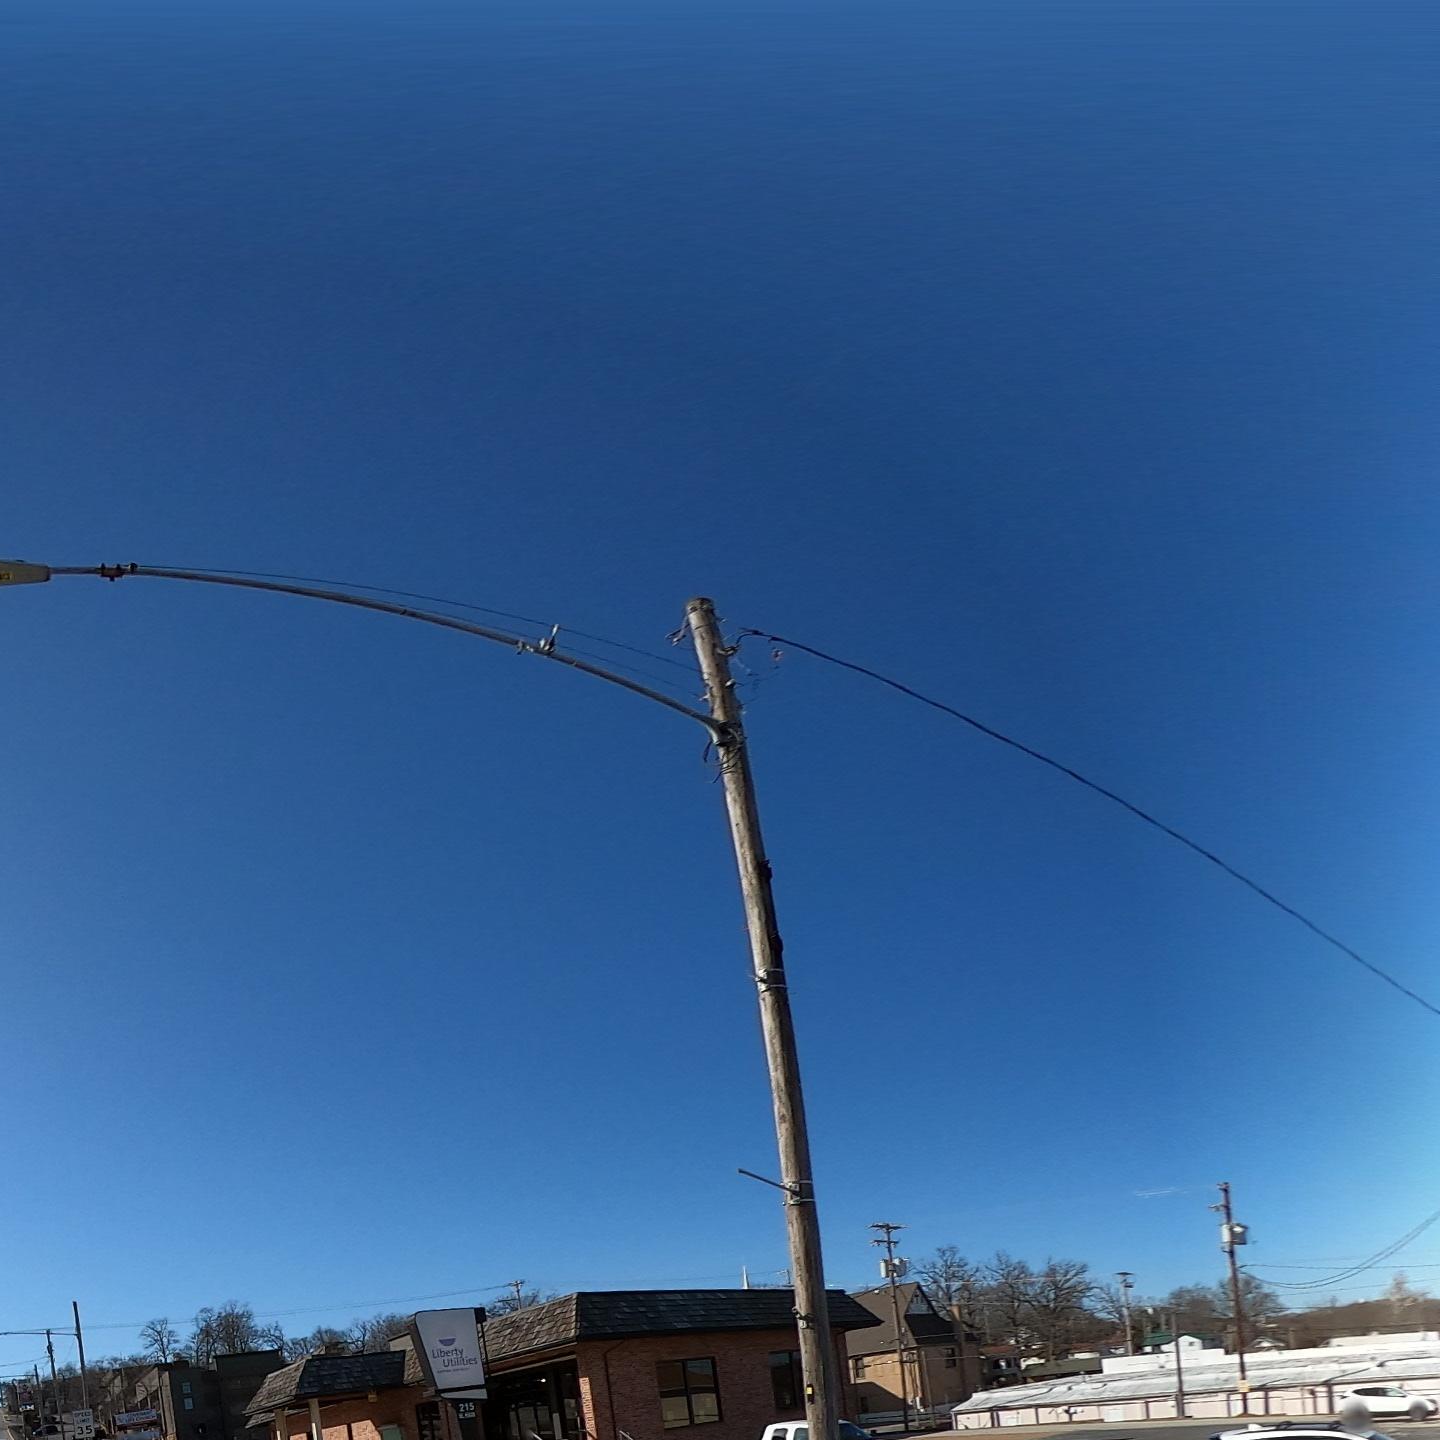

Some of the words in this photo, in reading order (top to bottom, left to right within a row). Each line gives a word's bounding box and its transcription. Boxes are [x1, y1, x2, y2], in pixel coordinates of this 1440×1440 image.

[432, 1348, 463, 1359] Liberty
[443, 1356, 478, 1367] Utilities
[459, 1402, 475, 1412] 215
[77, 1425, 93, 1435] 35
